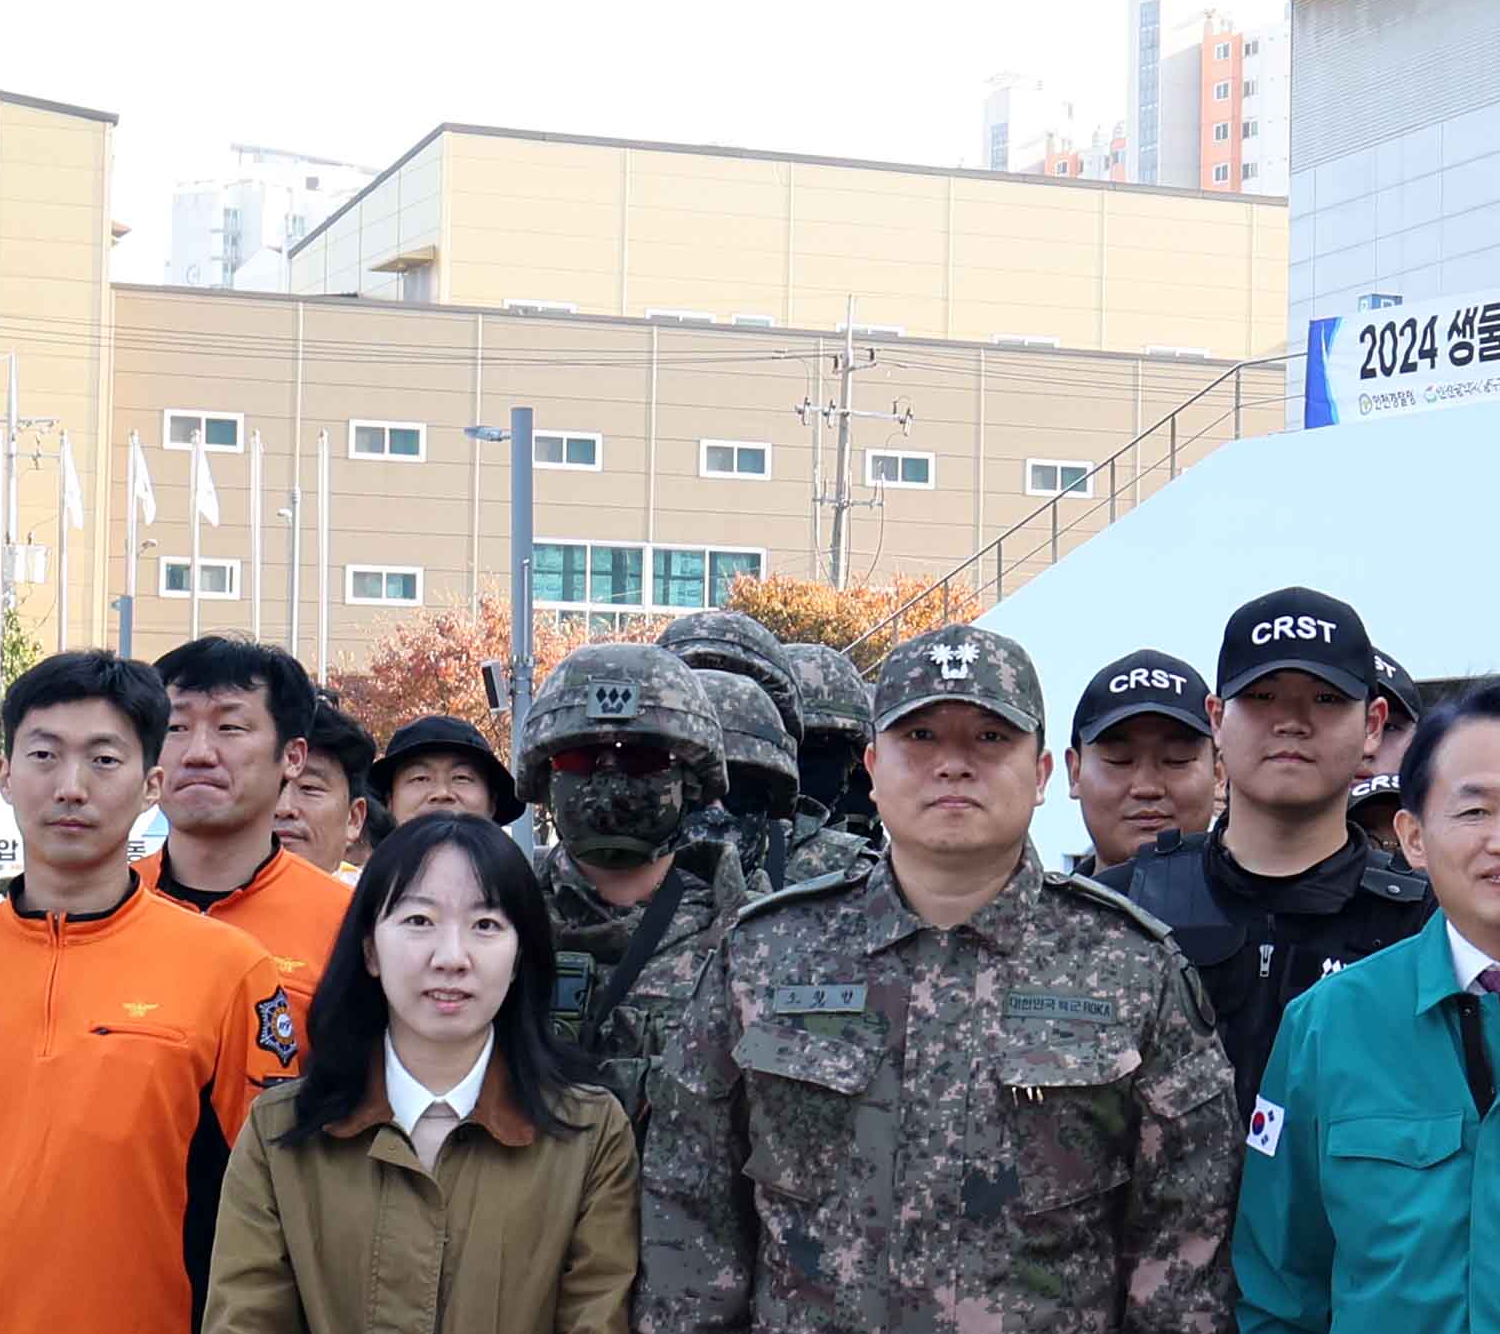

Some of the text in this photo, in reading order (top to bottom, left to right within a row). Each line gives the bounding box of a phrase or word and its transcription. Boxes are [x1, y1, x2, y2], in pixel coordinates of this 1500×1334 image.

[1359, 315, 1438, 379] 2024
[1252, 615, 1336, 645] CRST
[1109, 667, 1187, 695] CRST
[1352, 774, 1400, 797] CRS
